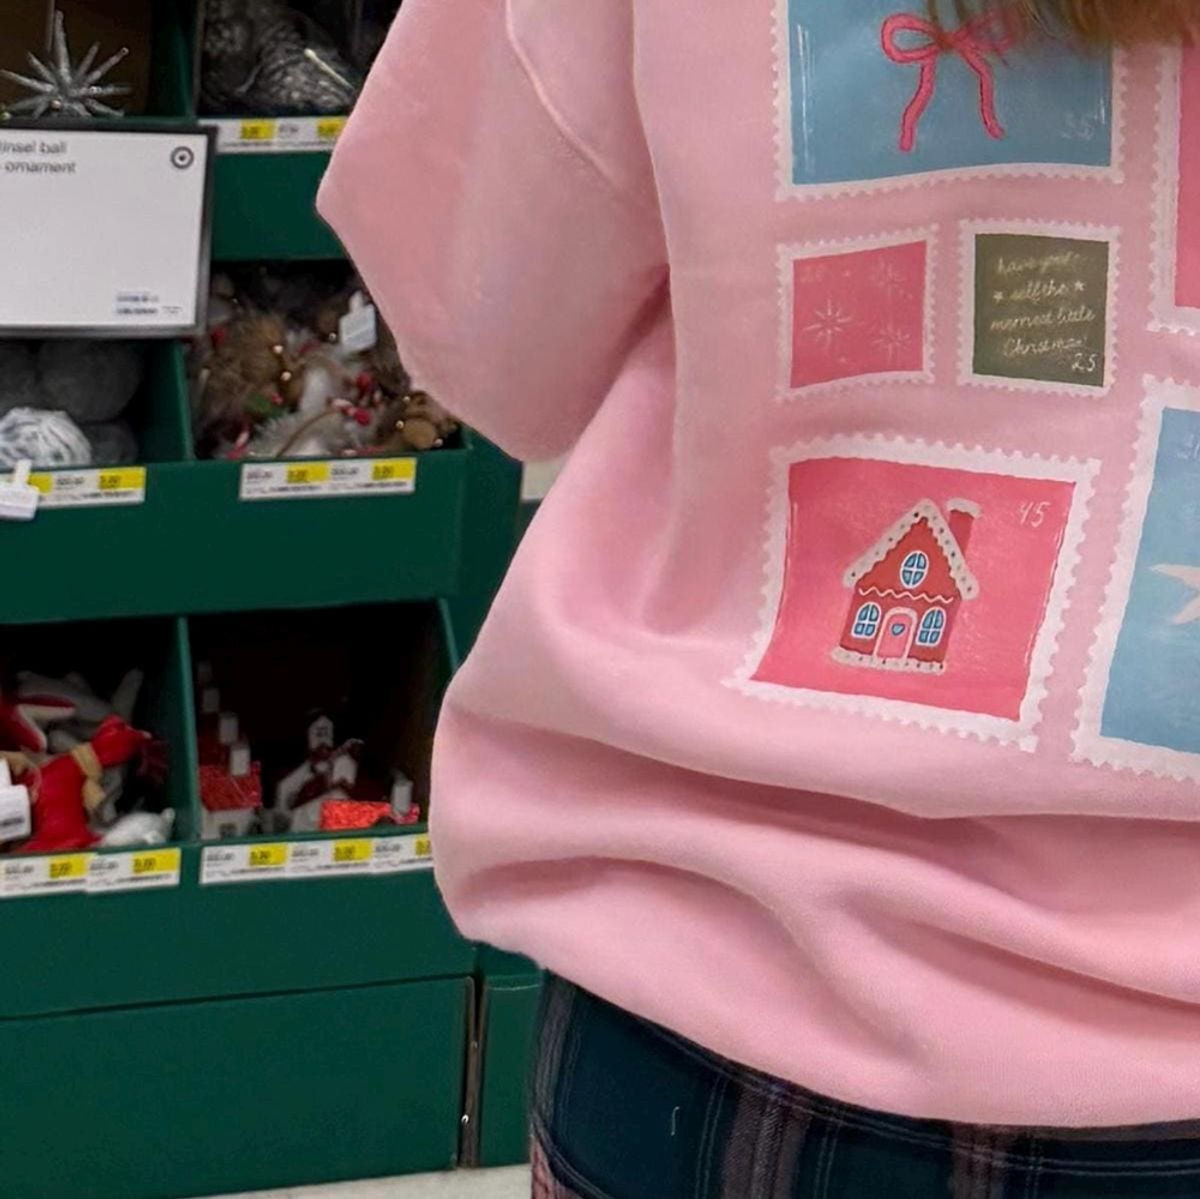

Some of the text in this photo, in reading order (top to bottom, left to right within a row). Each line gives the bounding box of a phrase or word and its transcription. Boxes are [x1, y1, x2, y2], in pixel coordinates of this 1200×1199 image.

[40, 141, 67, 154] ball
[5, 161, 76, 174] ornament
[1071, 352, 1098, 373] 25
